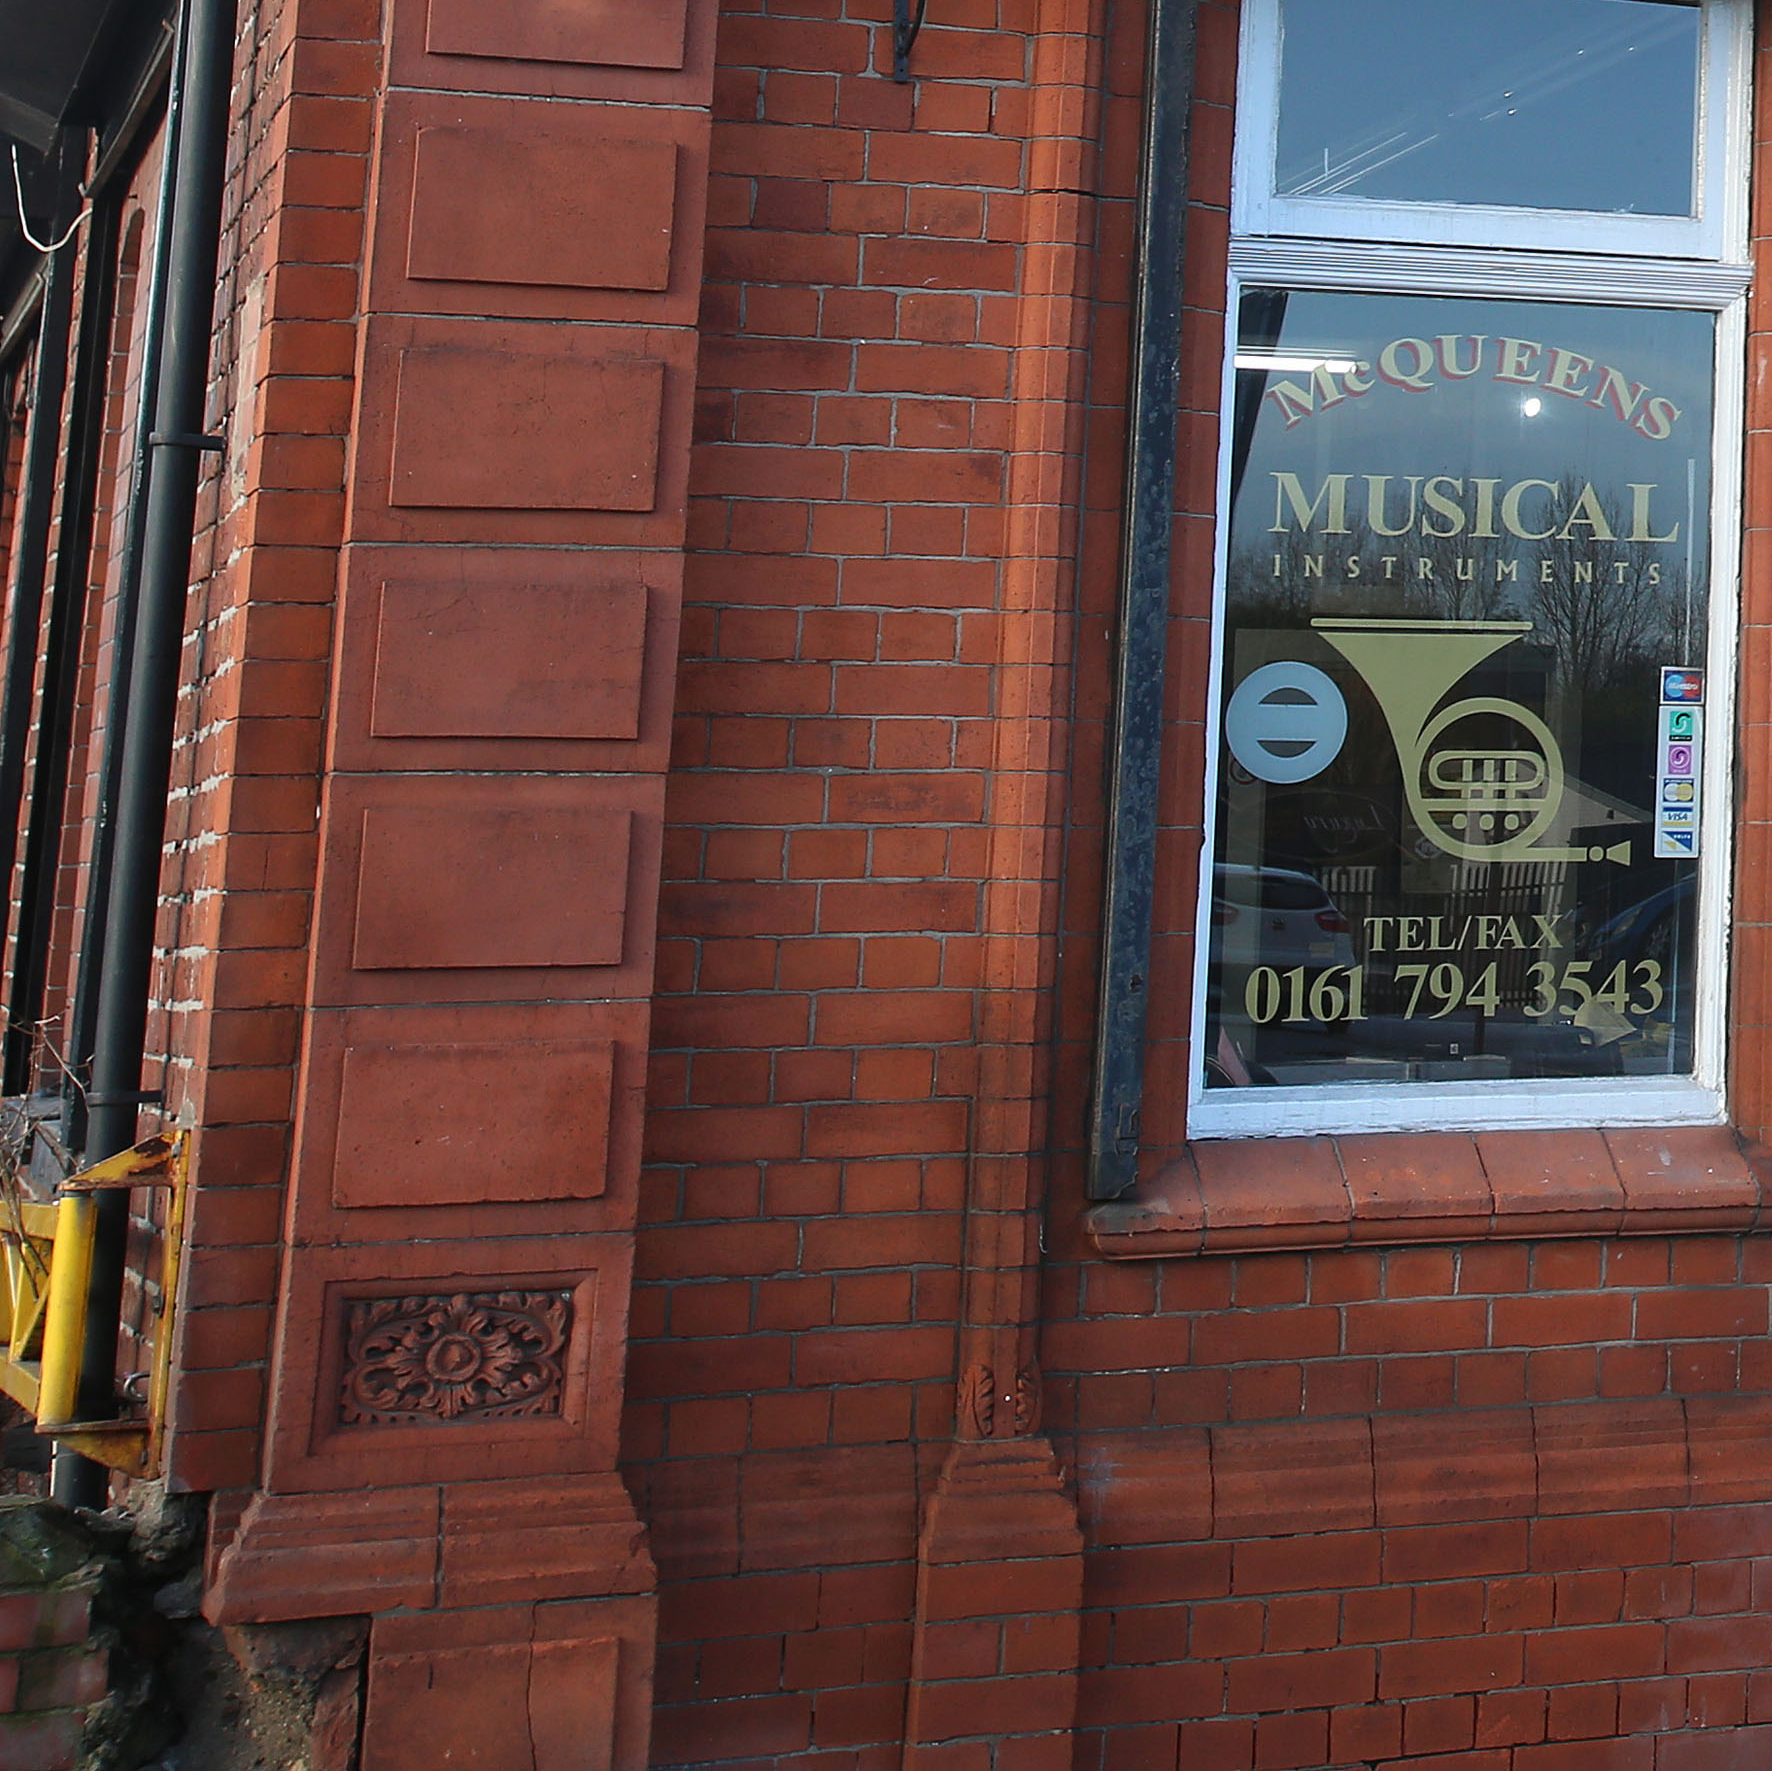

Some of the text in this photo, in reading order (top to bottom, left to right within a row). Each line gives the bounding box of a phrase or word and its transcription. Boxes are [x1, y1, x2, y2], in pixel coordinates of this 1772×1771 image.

[1267, 334, 1682, 441] McQUEENS
[1267, 471, 1680, 544] MUSICAL
[1273, 554, 1661, 586] INSTRUMENTS
[1363, 914, 1566, 953] TEL/FAX
[1244, 958, 1665, 1024] 0161 794 3543
